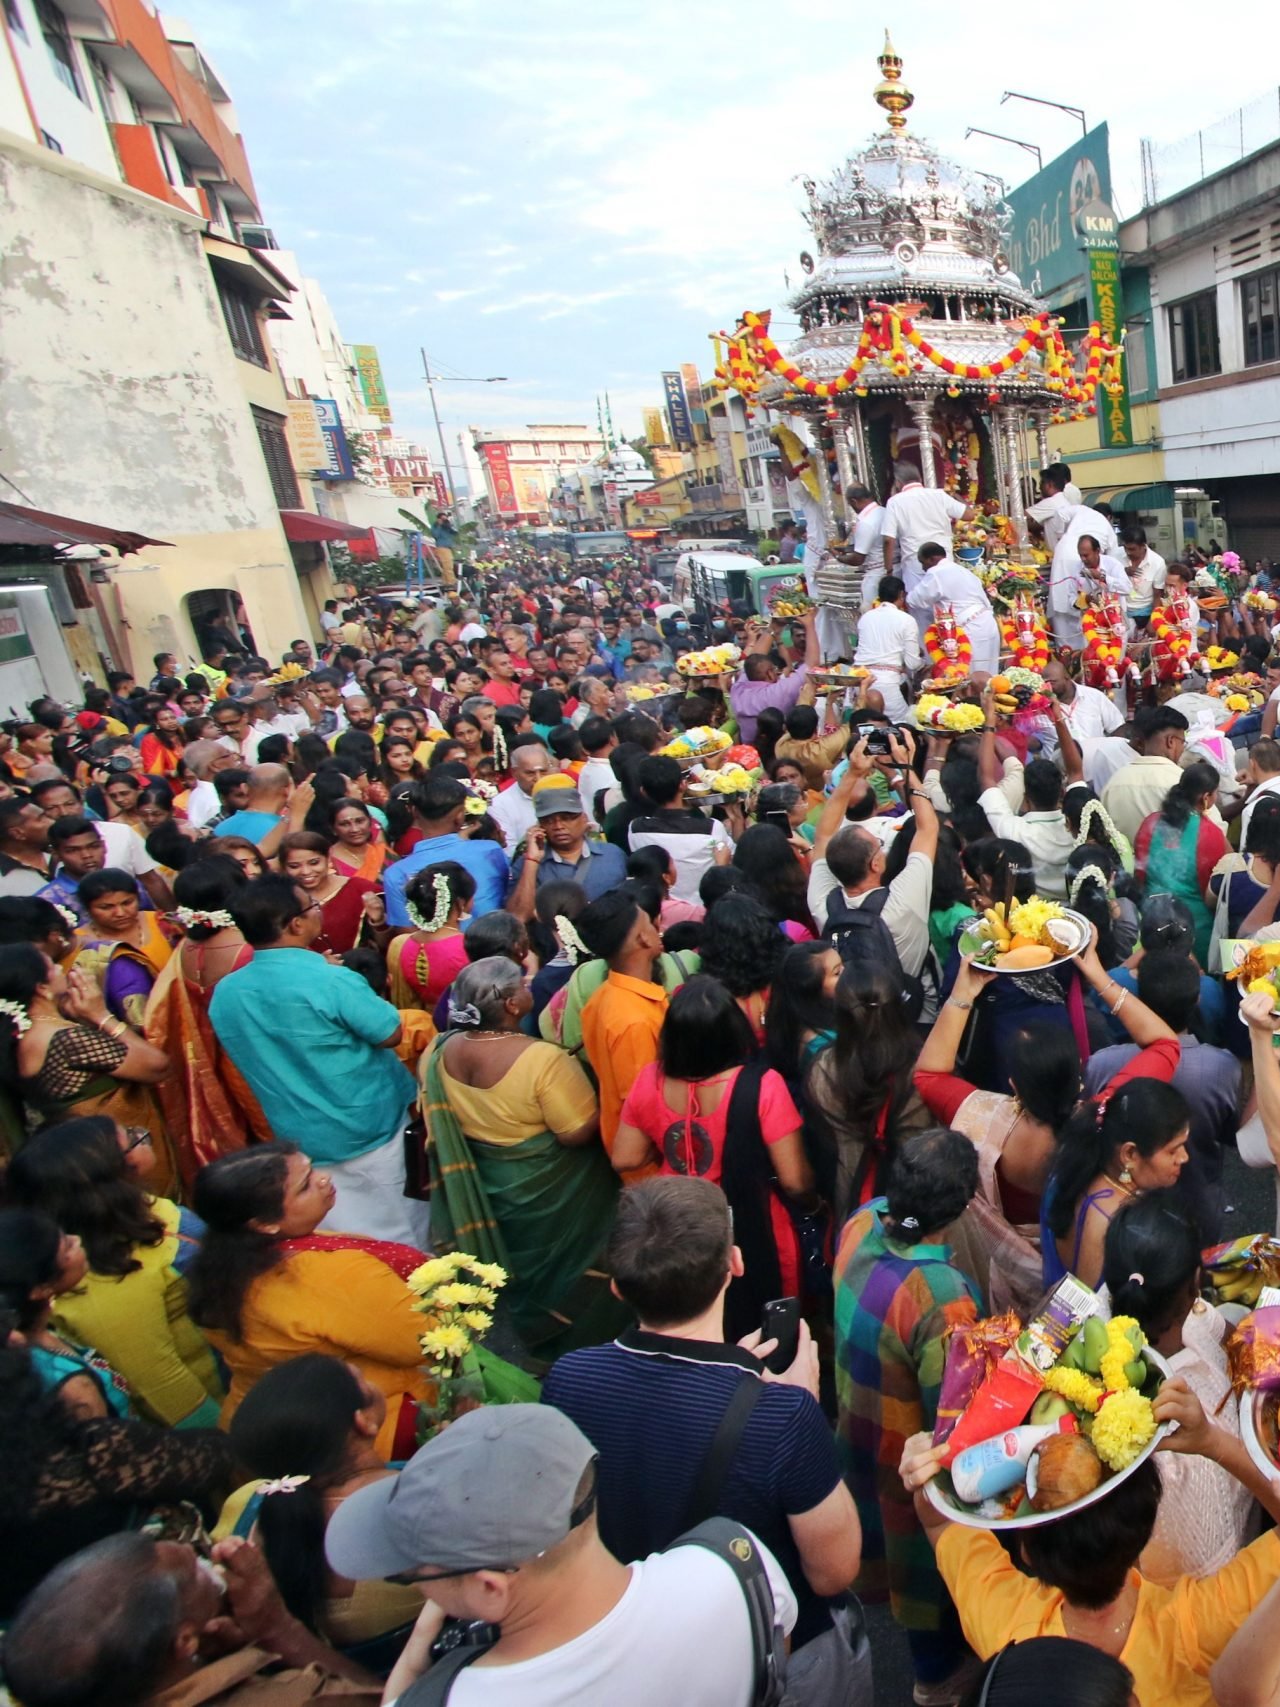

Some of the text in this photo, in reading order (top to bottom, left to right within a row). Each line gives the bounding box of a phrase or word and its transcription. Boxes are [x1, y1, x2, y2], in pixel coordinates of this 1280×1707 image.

[1086, 216, 1113, 232] KM
[1083, 237, 1119, 249] 24 JAM
[666, 376, 687, 436] KHALEEL
